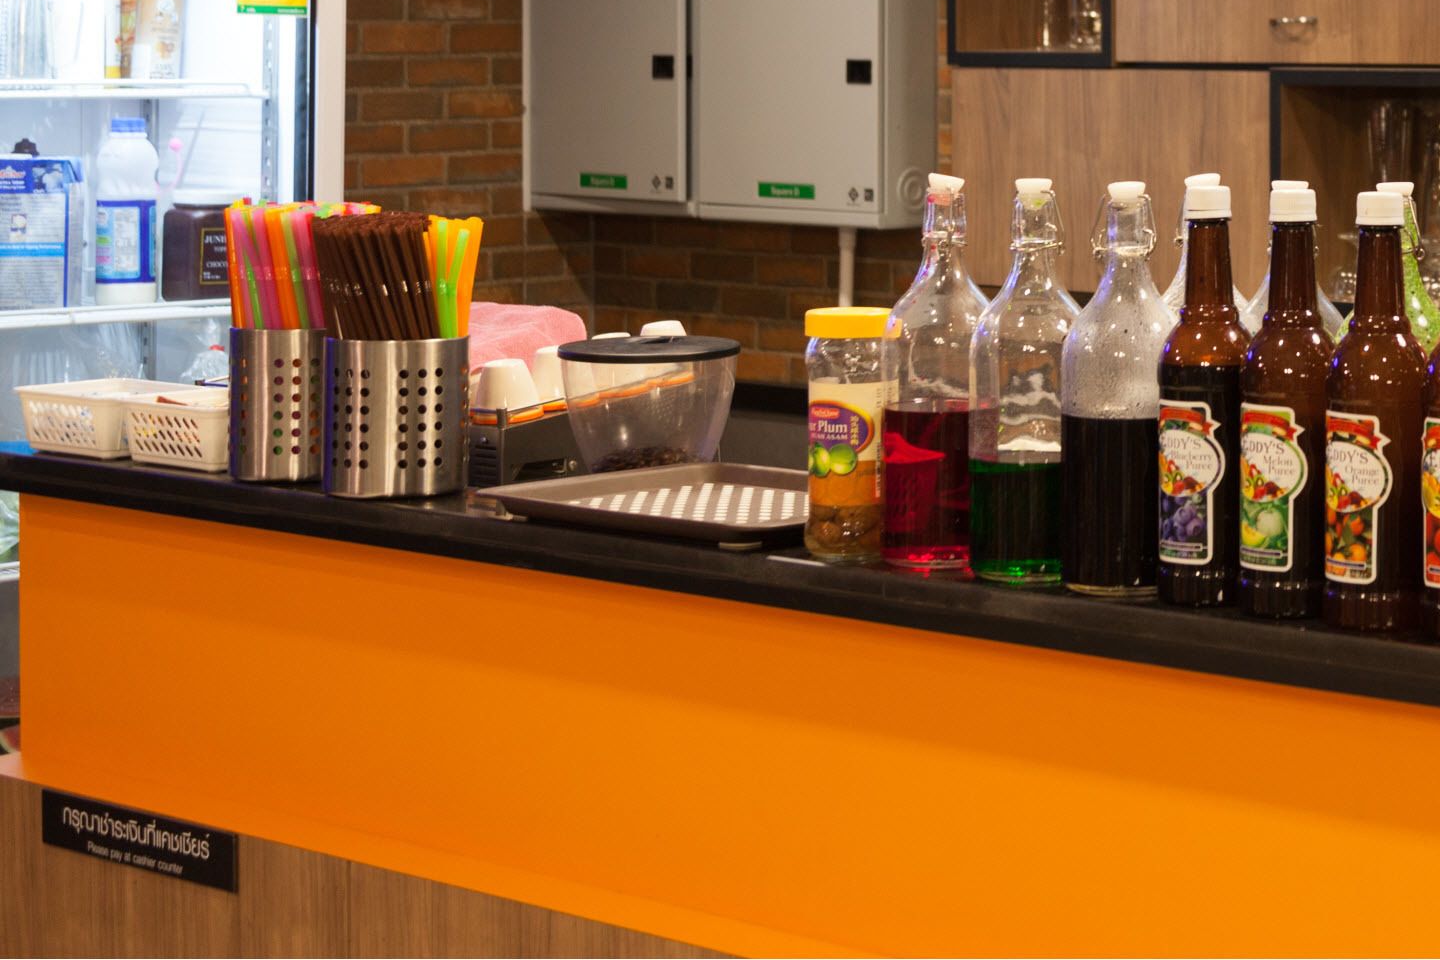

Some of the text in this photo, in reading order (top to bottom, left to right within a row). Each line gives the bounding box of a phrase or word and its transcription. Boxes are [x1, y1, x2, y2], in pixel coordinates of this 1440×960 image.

[818, 419, 848, 433] Plum
[1263, 455, 1293, 467] Melon
[1345, 464, 1380, 477] Orange
[63, 806, 210, 860] กรุณาชำระเงินที่แคชเชียร์
[87, 840, 183, 875] Please pay at cashier counter
